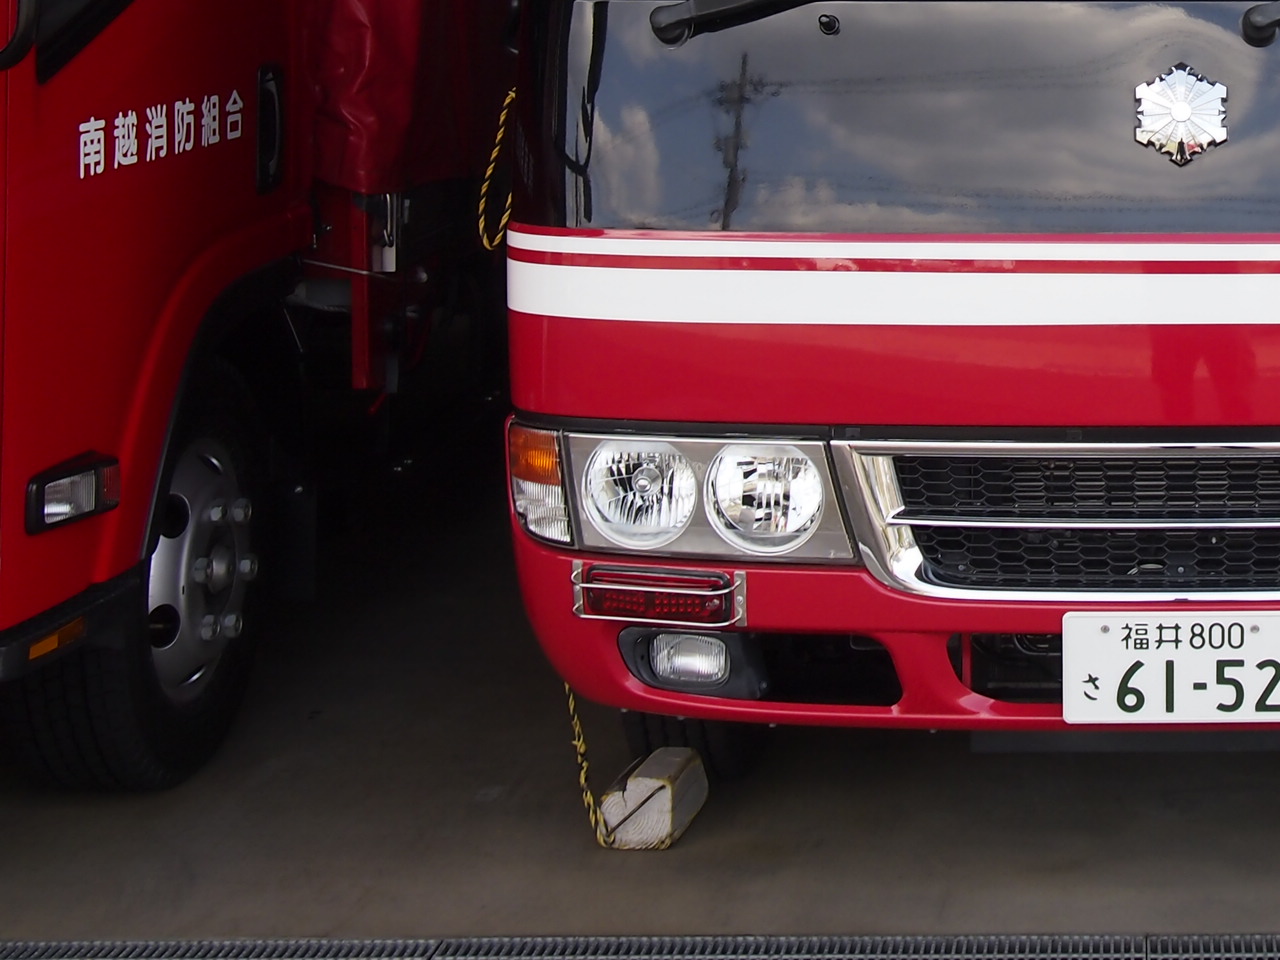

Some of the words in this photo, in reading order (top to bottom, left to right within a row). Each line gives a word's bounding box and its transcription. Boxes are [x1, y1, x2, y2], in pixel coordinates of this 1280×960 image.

[78, 89, 244, 180] 南越消防組合
[1081, 673, 1100, 701] さ
